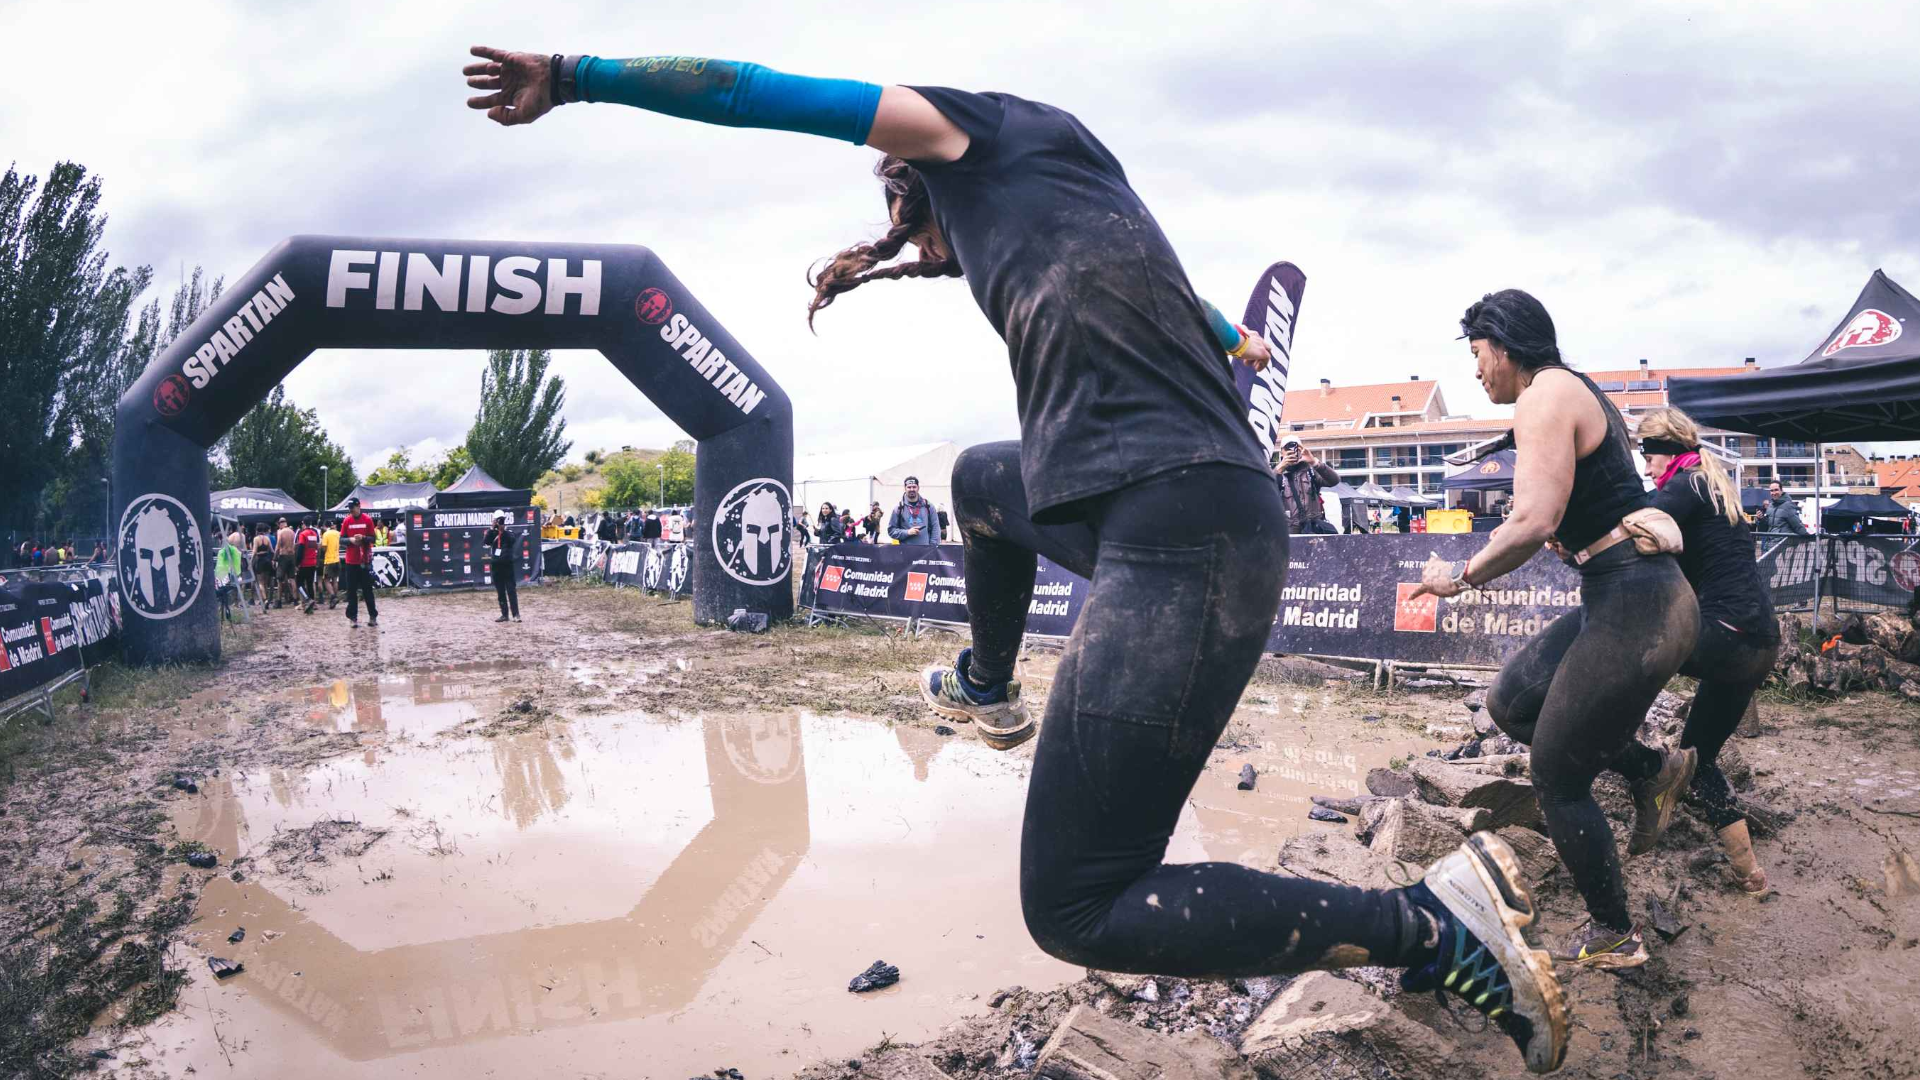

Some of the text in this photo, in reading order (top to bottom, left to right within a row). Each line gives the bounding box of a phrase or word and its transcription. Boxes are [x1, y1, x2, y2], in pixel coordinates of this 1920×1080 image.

[326, 249, 602, 316] FINISH
[182, 272, 296, 389] SPARTAN
[660, 313, 767, 415] SPARTAN
[1247, 275, 1295, 466] PARTAN
[220, 497, 284, 510] SPARTAN
[434, 513, 467, 527] SPARTAN
[843, 568, 894, 583] Comunidad
[854, 583, 890, 598] Madrid
[925, 589, 938, 603] de
[1033, 581, 1073, 596] unidad
[1281, 583, 1361, 602] munidad
[1283, 605, 1359, 629] Madrid
[1442, 611, 1561, 637] de Madr
[1, 619, 37, 643] Comunidad
[9, 641, 43, 668] de Madrid
